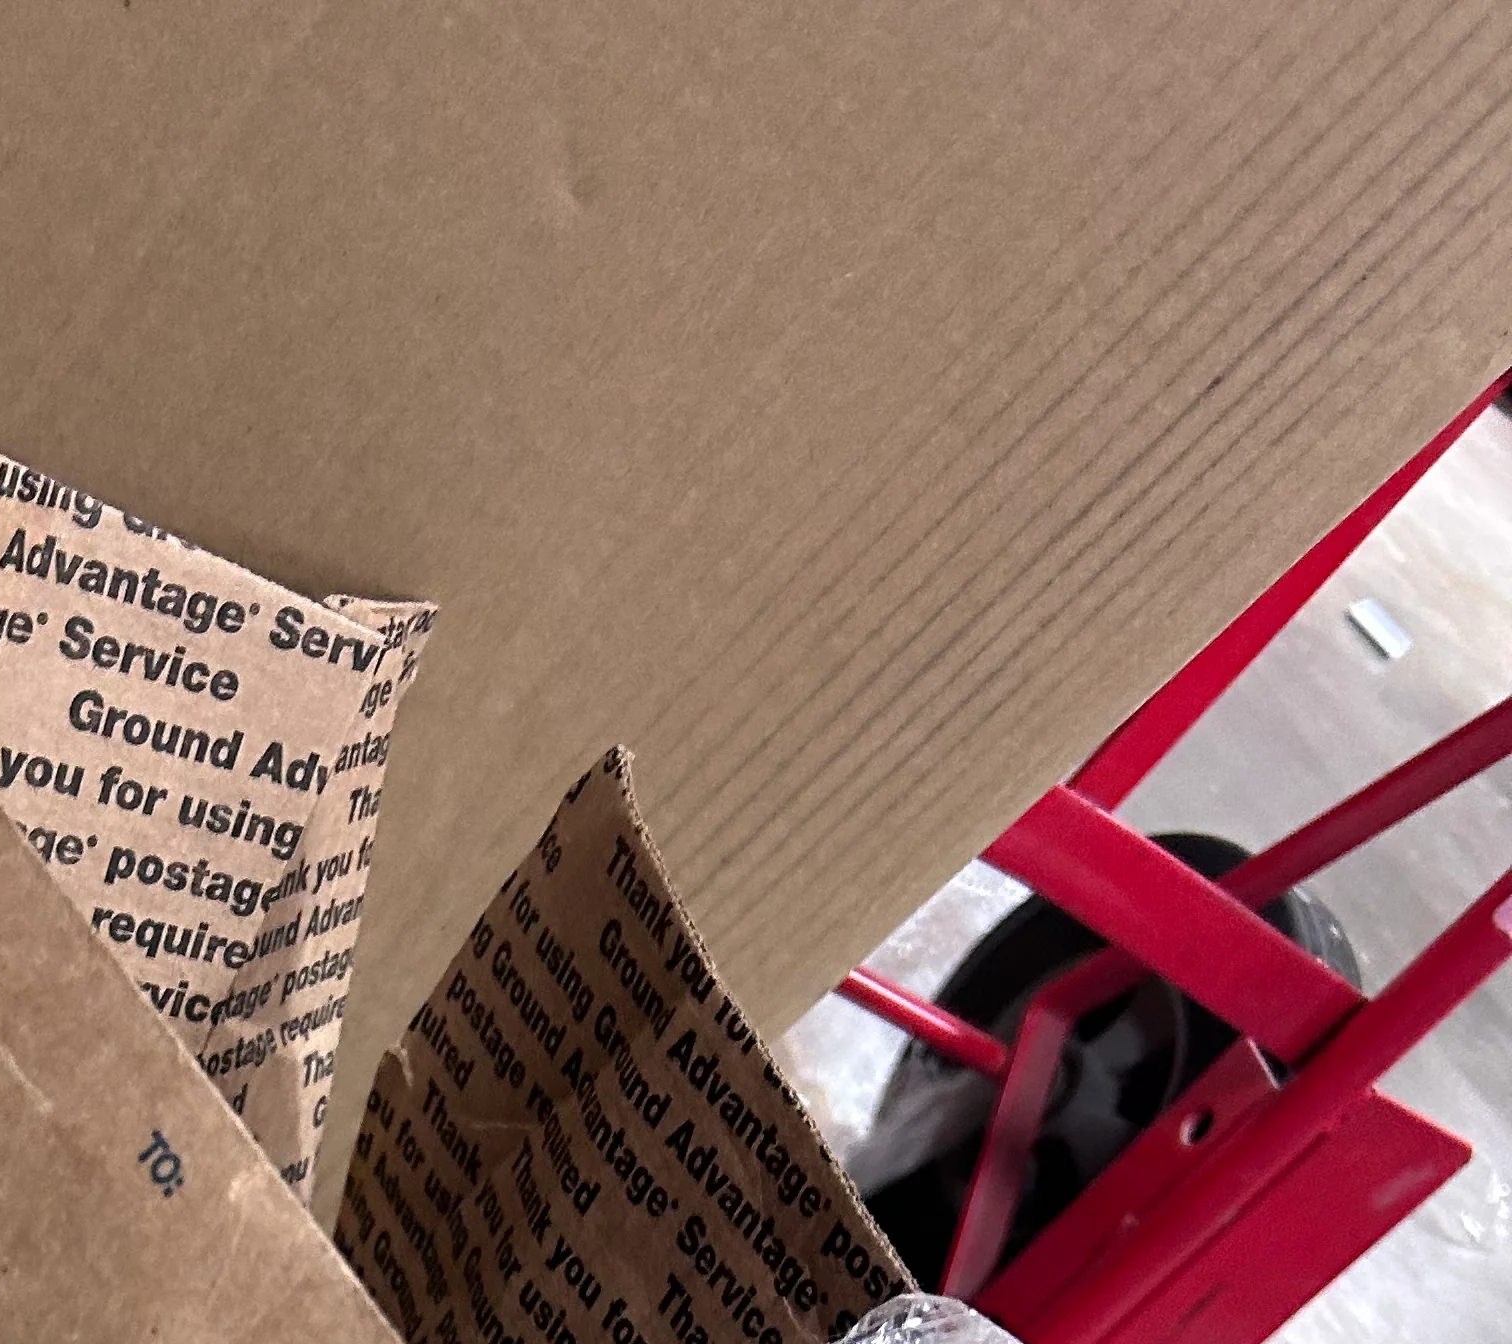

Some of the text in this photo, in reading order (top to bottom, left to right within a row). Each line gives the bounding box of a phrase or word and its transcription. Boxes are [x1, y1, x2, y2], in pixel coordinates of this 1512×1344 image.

[58, 615, 239, 702] Service
[68, 689, 245, 771] Ground
[97, 765, 169, 816] for
[177, 794, 305, 862] using
[606, 834, 716, 1003] Thank you
[491, 940, 568, 1058] Ground
[535, 927, 595, 1025] using
[593, 1002, 673, 1130] Ground
[599, 918, 677, 1041] Ground
[422, 1077, 484, 1187] Thank
[446, 969, 527, 1090] postage
[523, 1082, 602, 1217] required
[509, 1136, 556, 1246] Thank
[543, 1235, 602, 1312] you
